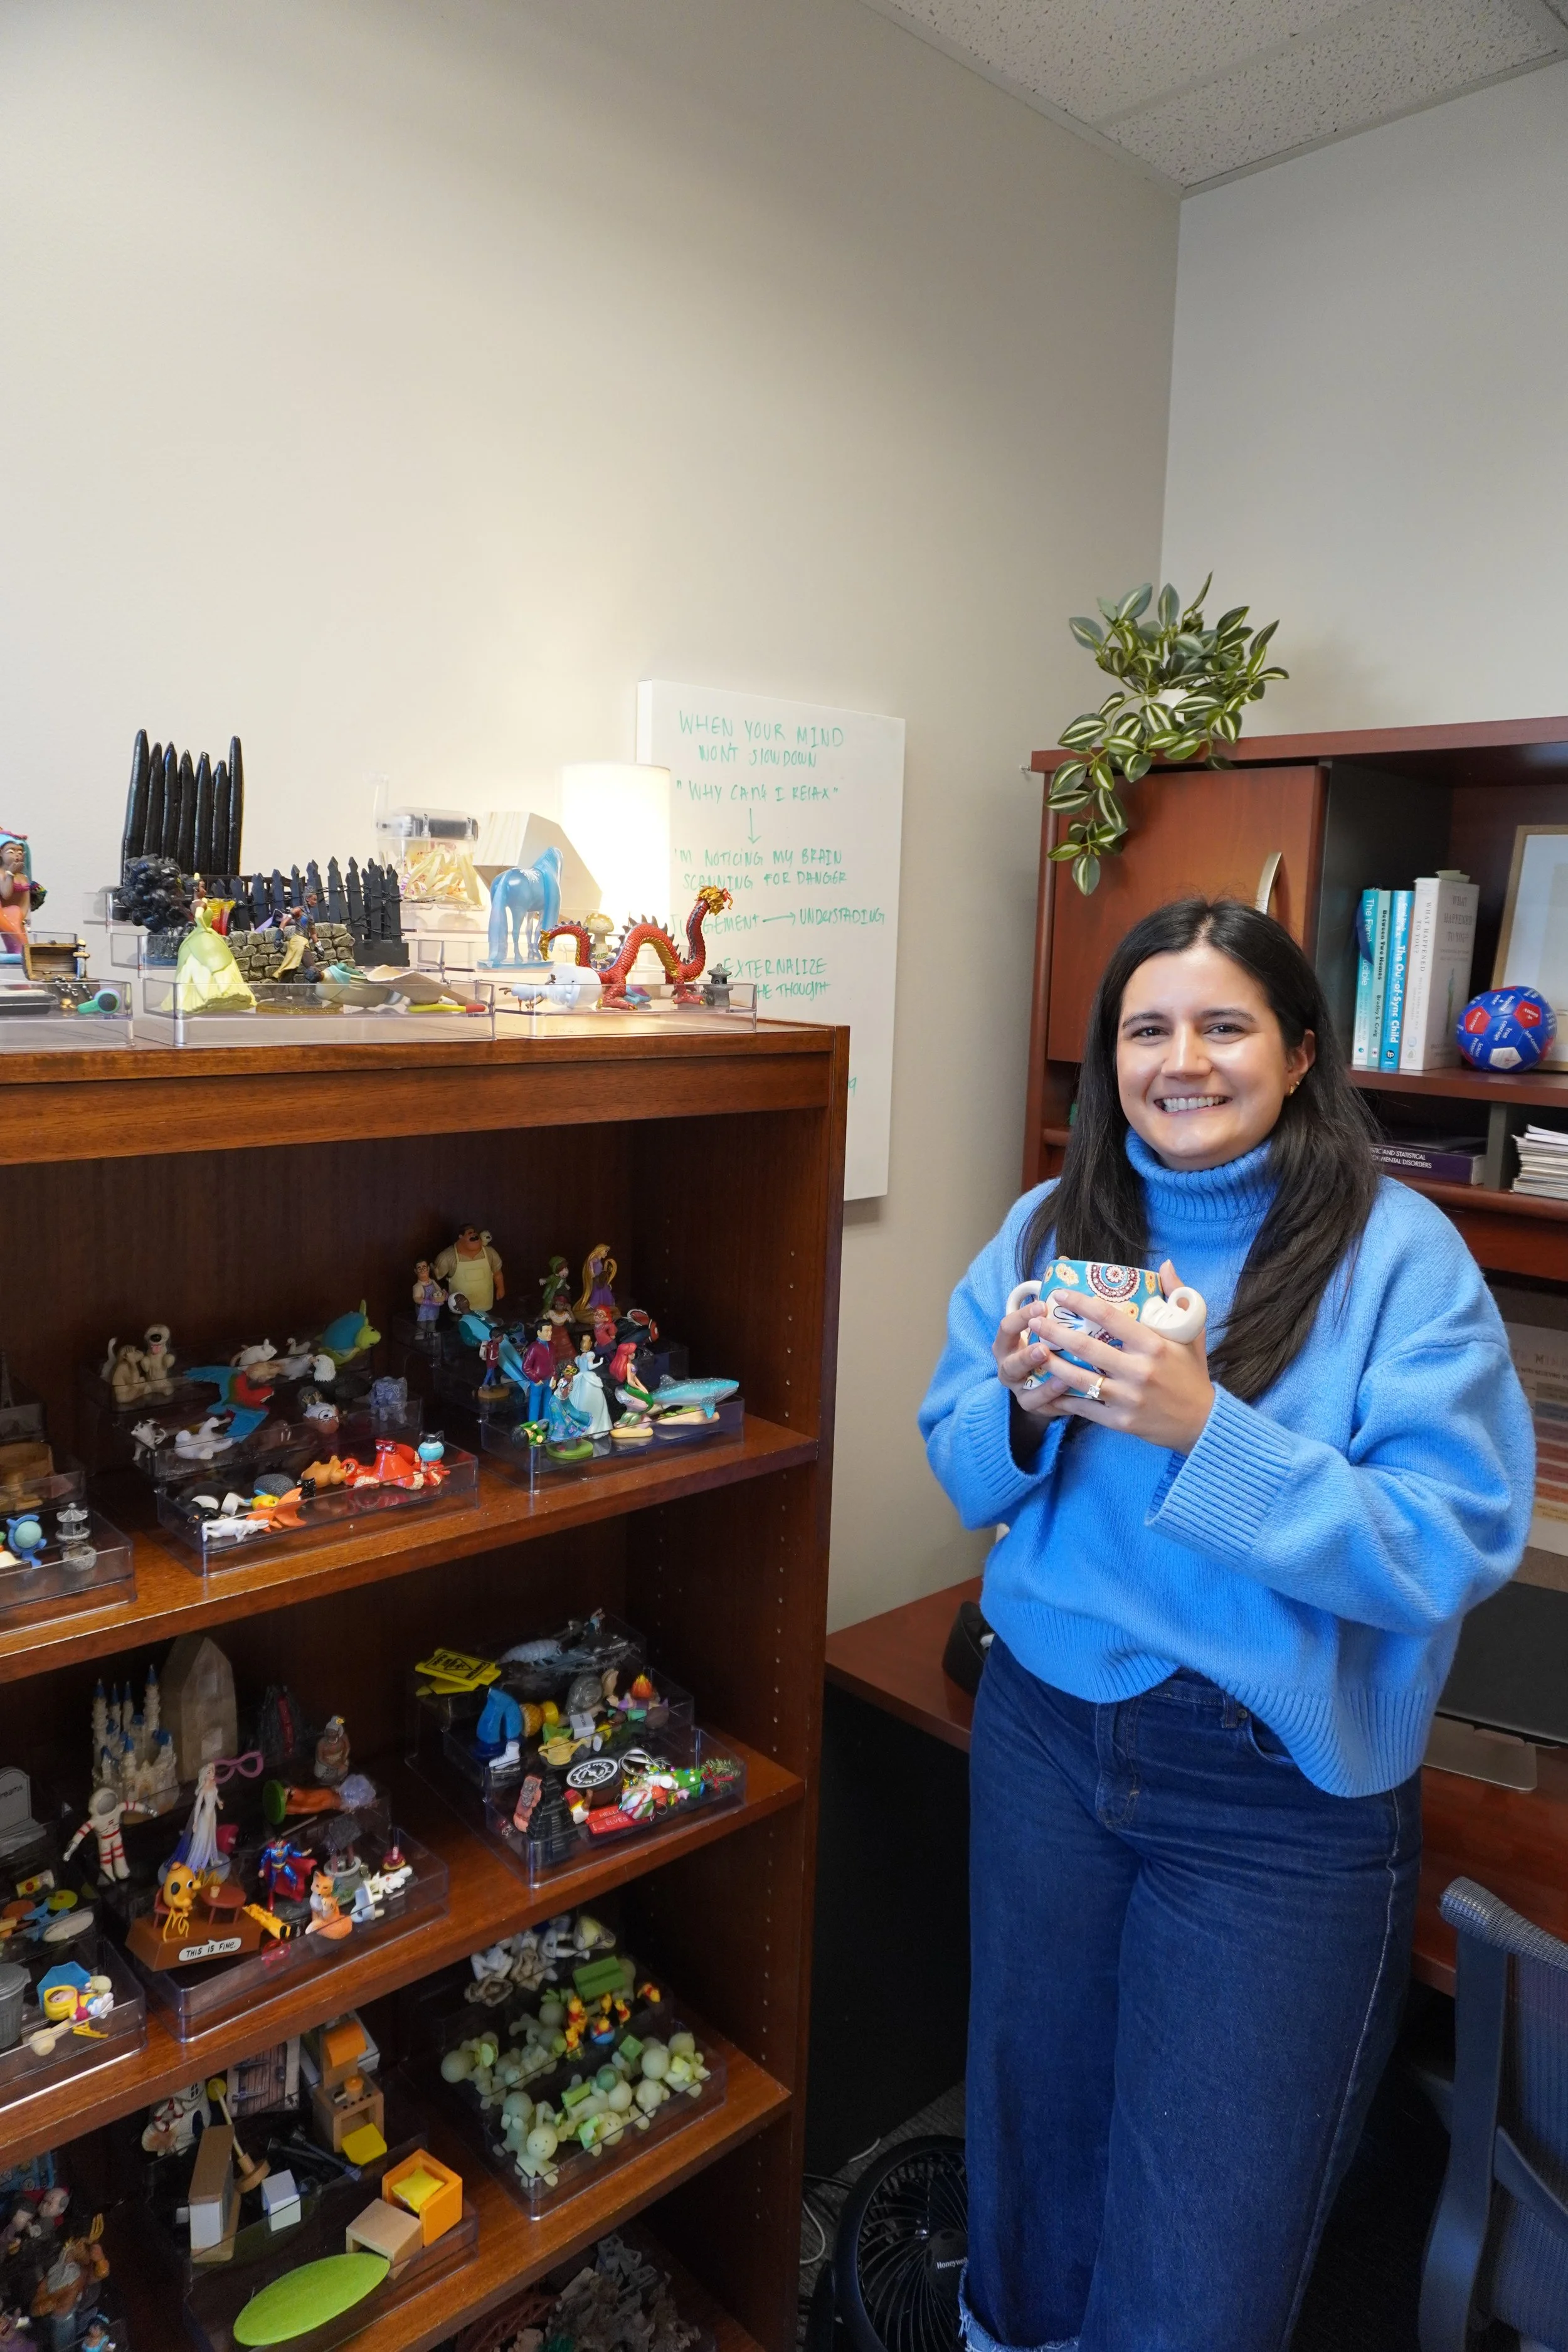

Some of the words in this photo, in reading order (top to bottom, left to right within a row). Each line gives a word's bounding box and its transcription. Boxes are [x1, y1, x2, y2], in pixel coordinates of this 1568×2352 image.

[679, 710, 733, 737] WHEN
[744, 720, 785, 742] YOUR
[797, 726, 844, 748] MIND
[699, 742, 739, 763] WON'T
[775, 787, 785, 802] I
[705, 848, 763, 867] NOTICING
[773, 849, 793, 868] MY
[802, 848, 842, 866] BRAIN
[763, 872, 791, 886] FOR
[797, 871, 848, 885] DANGER
[1365, 898, 1374, 916] The
[670, 913, 759, 938] JUGEMENT
[1364, 919, 1374, 941] Famil
[1396, 945, 1406, 961] The
[1420, 928, 1429, 972] HAPPENED
[723, 958, 828, 978] EXTERNALIZE
[1362, 959, 1370, 985] ucible
[756, 983, 772, 1000] HE
[1468, 1011, 1481, 1031] Revenge
[1390, 1020, 1400, 1043] Child
[1502, 1027, 1513, 1039] True
[1380, 1156, 1402, 1165] MENTAL
[1402, 1159, 1433, 1169] DISORDERS
[1396, 1150, 1426, 1161] STATISTICAL
[605, 1816, 628, 1826] ELVES
[186, 1947, 203, 1957] THIS
[208, 1944, 215, 1953] IS
